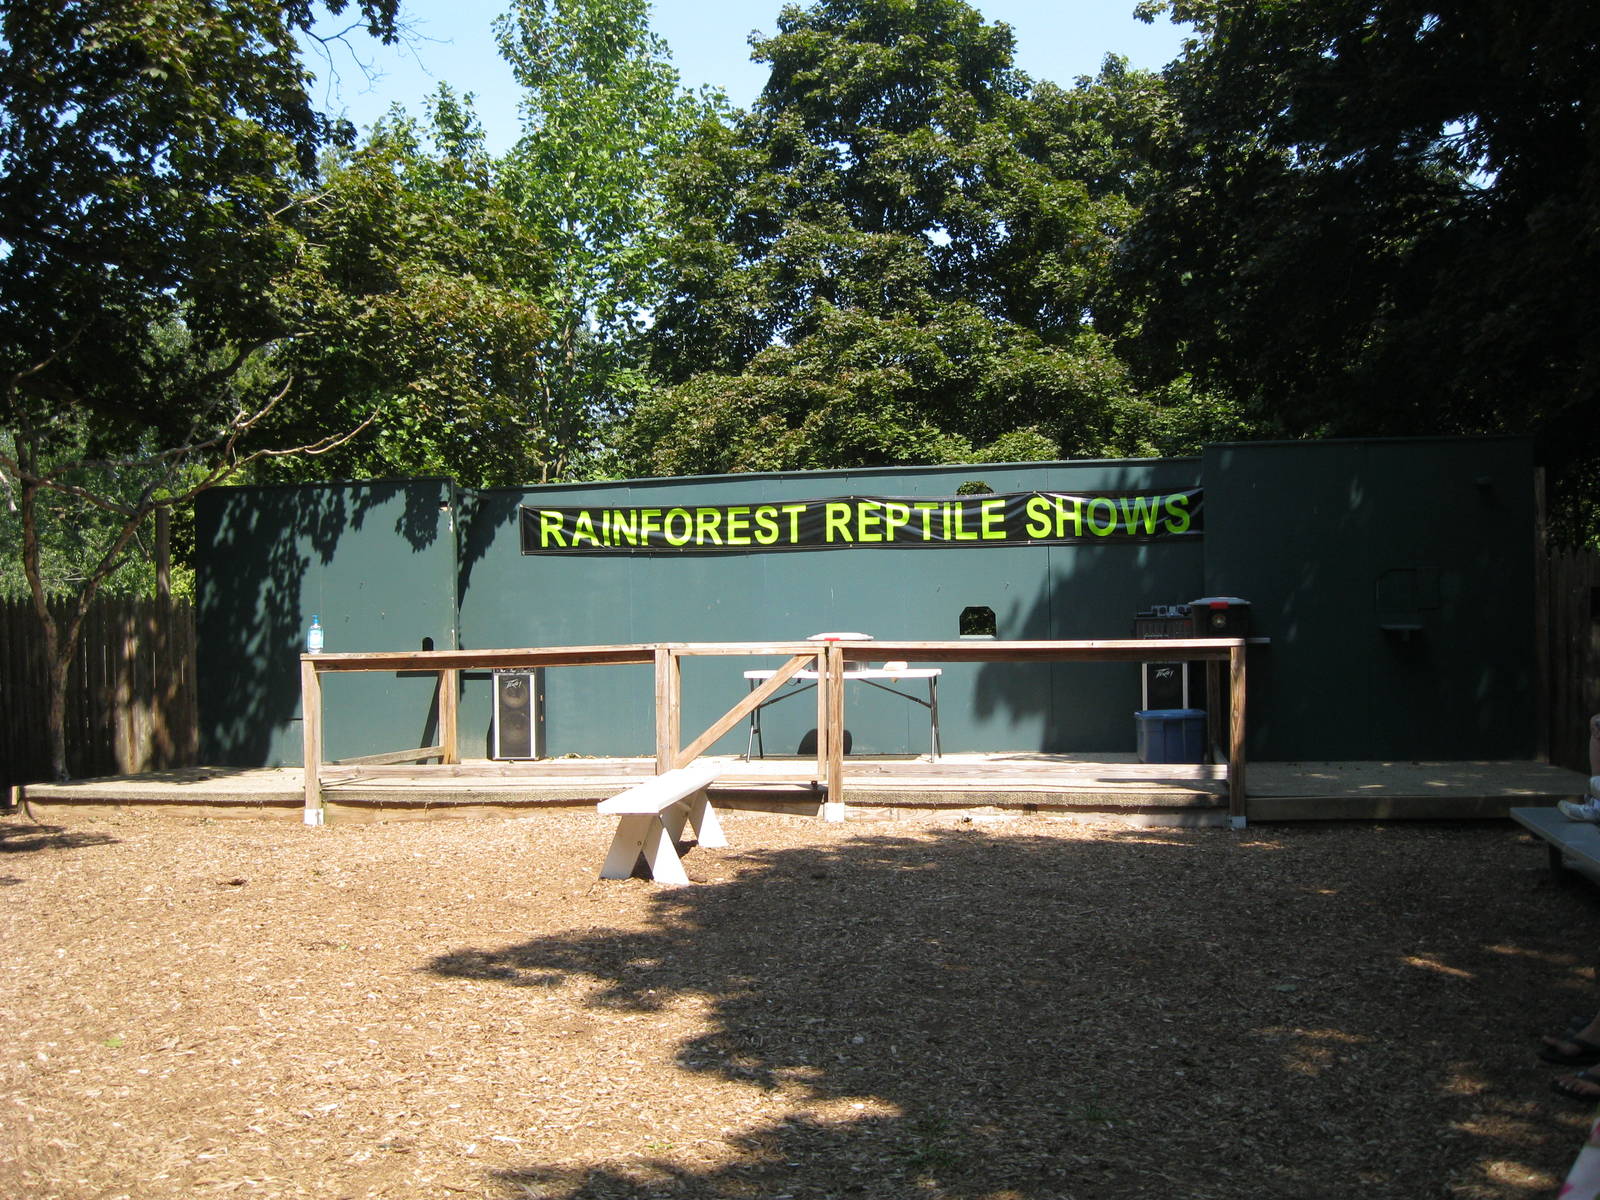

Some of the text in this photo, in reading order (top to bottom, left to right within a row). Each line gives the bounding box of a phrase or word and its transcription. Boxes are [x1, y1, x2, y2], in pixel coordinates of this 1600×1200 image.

[540, 494, 1190, 547] RAINFOREST REPTILE SHOWS
